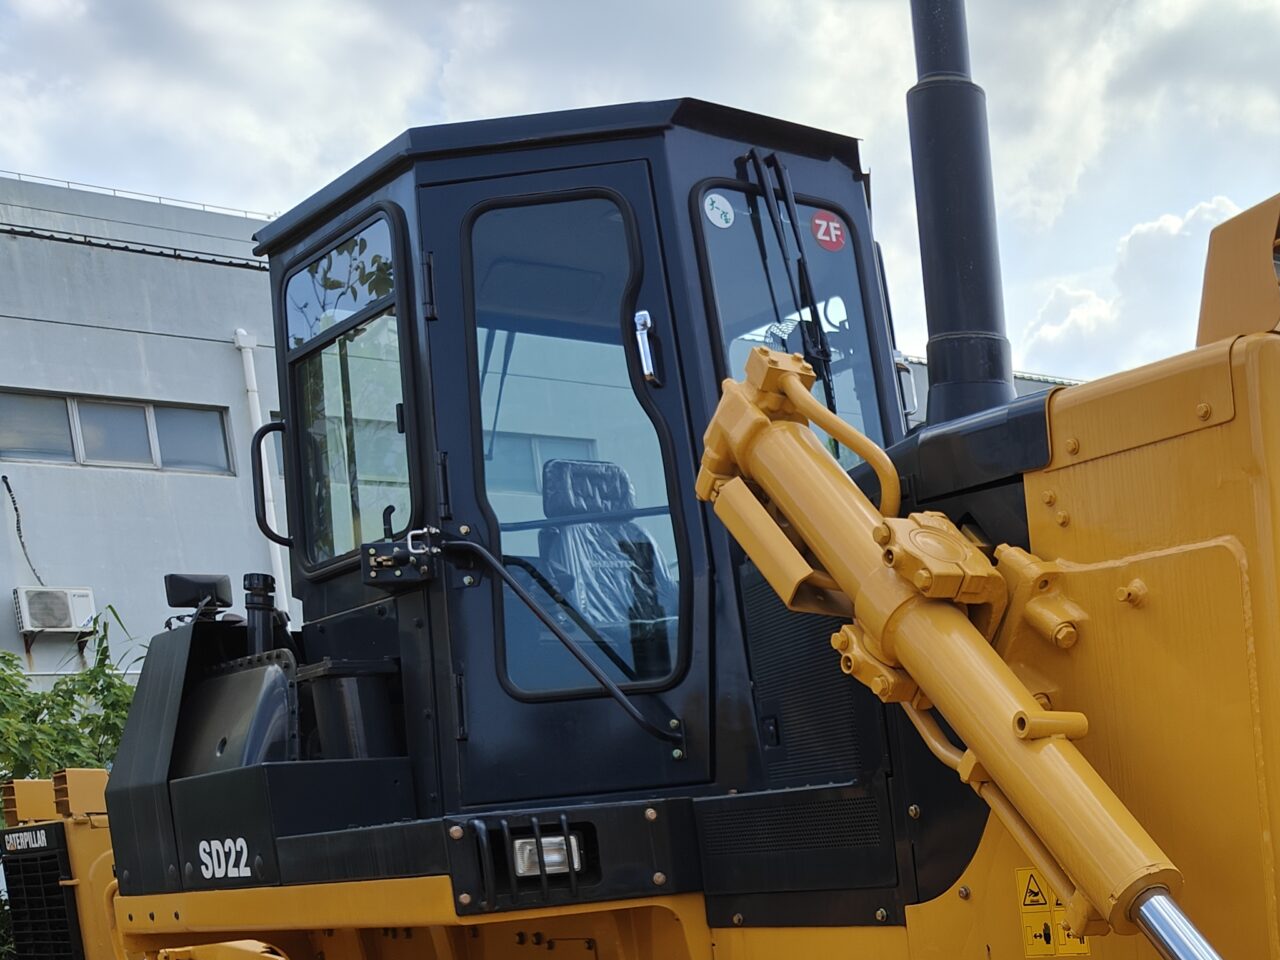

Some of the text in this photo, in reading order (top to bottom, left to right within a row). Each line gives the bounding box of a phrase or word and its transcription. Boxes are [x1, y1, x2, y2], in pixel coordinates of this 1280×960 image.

[815, 219, 841, 242] ZF
[4, 829, 47, 851] CATERPILLAR
[198, 837, 252, 879] SD22
